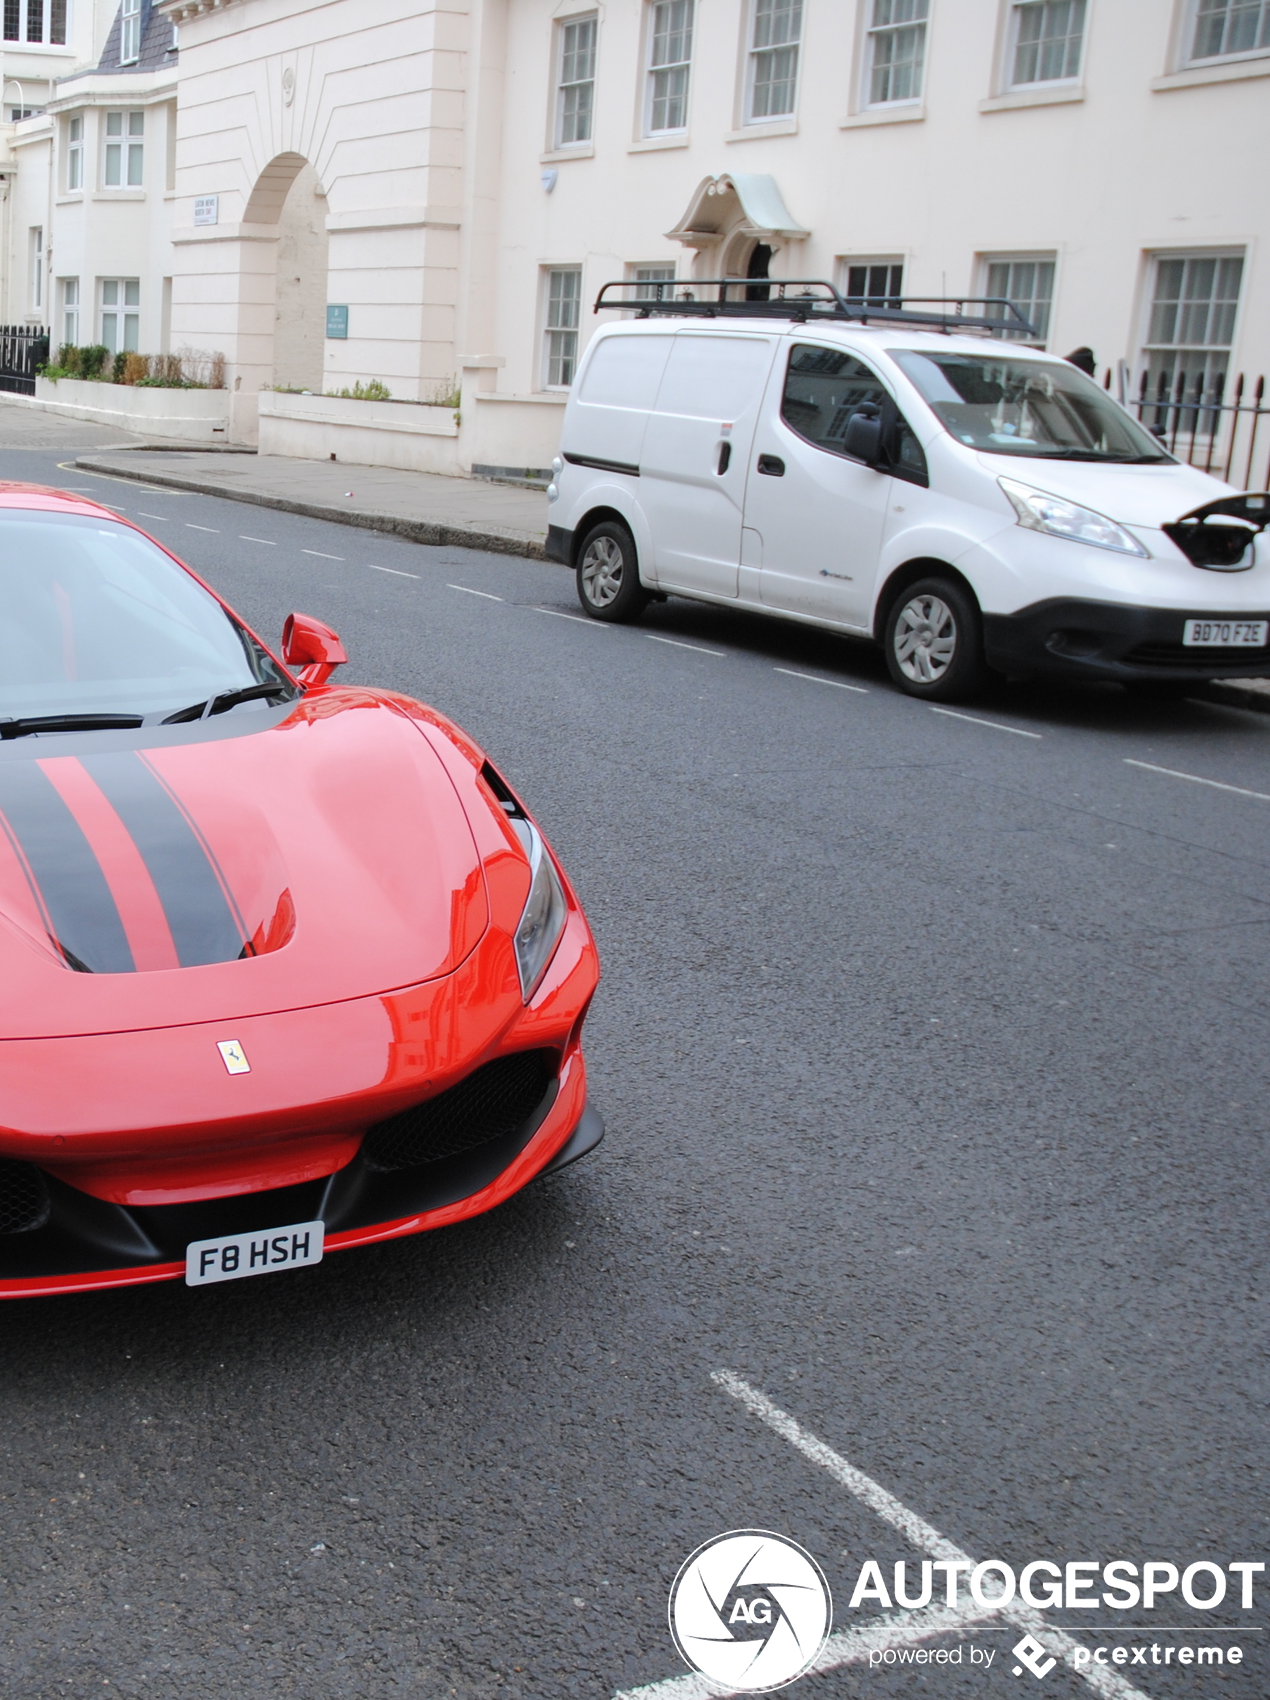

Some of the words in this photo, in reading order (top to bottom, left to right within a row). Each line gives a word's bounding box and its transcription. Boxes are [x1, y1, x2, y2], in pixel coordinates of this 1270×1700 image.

[1232, 623, 1261, 642] FZE
[199, 1245, 239, 1277] F8
[249, 1232, 310, 1269] HSH
